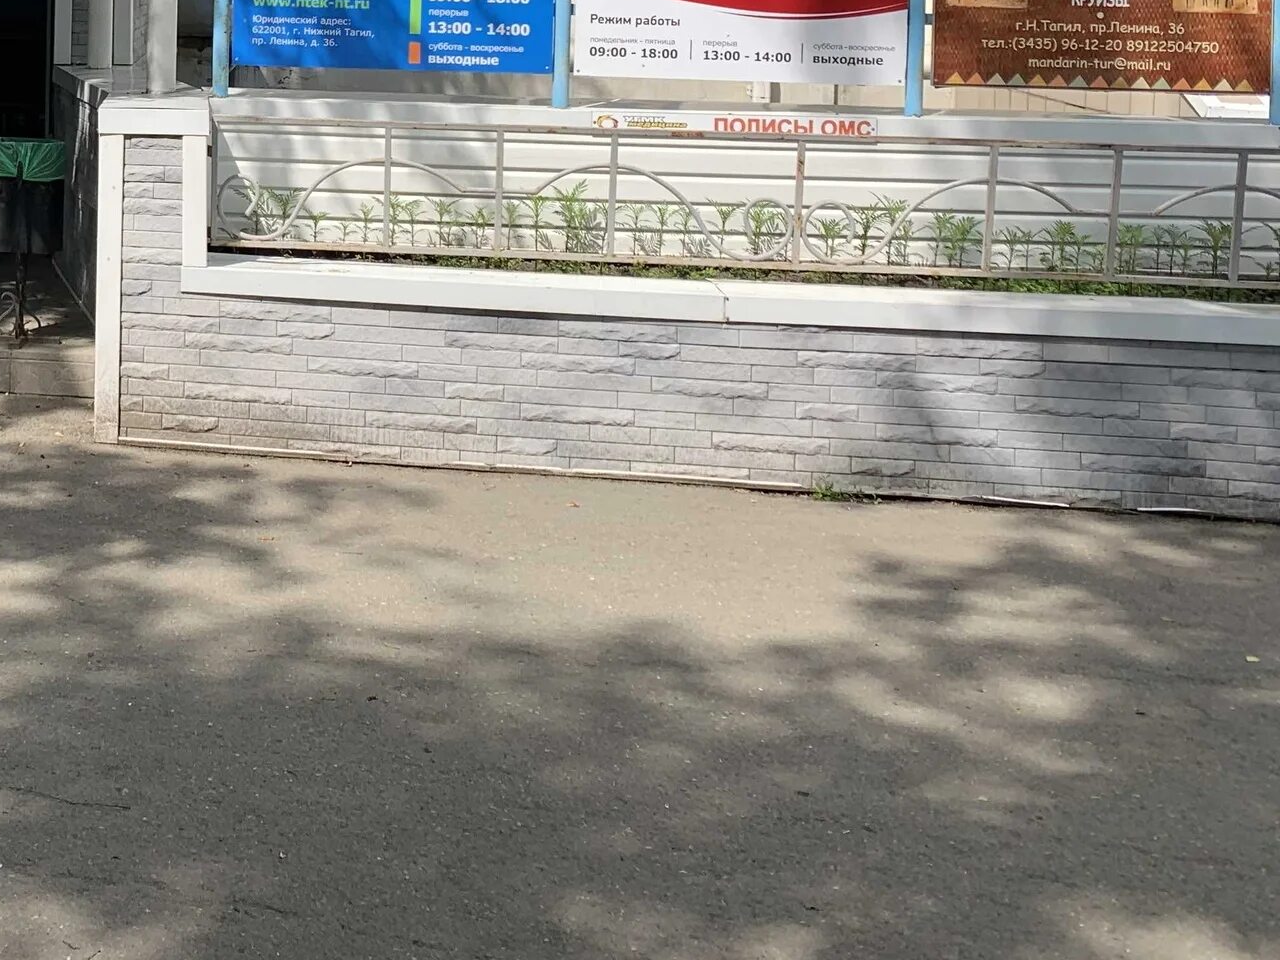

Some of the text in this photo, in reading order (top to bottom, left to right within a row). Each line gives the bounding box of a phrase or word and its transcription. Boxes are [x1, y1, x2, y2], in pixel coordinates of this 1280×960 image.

[428, 8, 468, 18] перерыв
[252, 15, 351, 28] Юридический адрес:
[590, 14, 681, 28] Режим работы
[252, 26, 290, 36] 622001,
[304, 27, 343, 37] Нижний
[346, 29, 375, 38] Тагил,
[428, 22, 530, 36] 13:00 14:00
[1168, 22, 1185, 34] 36
[252, 38, 268, 46] пр.
[270, 36, 308, 48] Ленина,
[323, 38, 337, 47] 36.
[428, 42, 524, 54] суббота воскресенье
[1061, 39, 1122, 52] 96-12-20
[1126, 40, 1220, 54] 89122504750
[428, 53, 499, 66] выходные
[590, 46, 678, 60] 09:00 18:00
[703, 50, 792, 63] 13:00 14:00
[813, 55, 884, 66] выходные
[1028, 57, 1171, 72] mandarin-tur@mail.ru
[714, 117, 872, 137] ПОЛИСЫ ОМС
